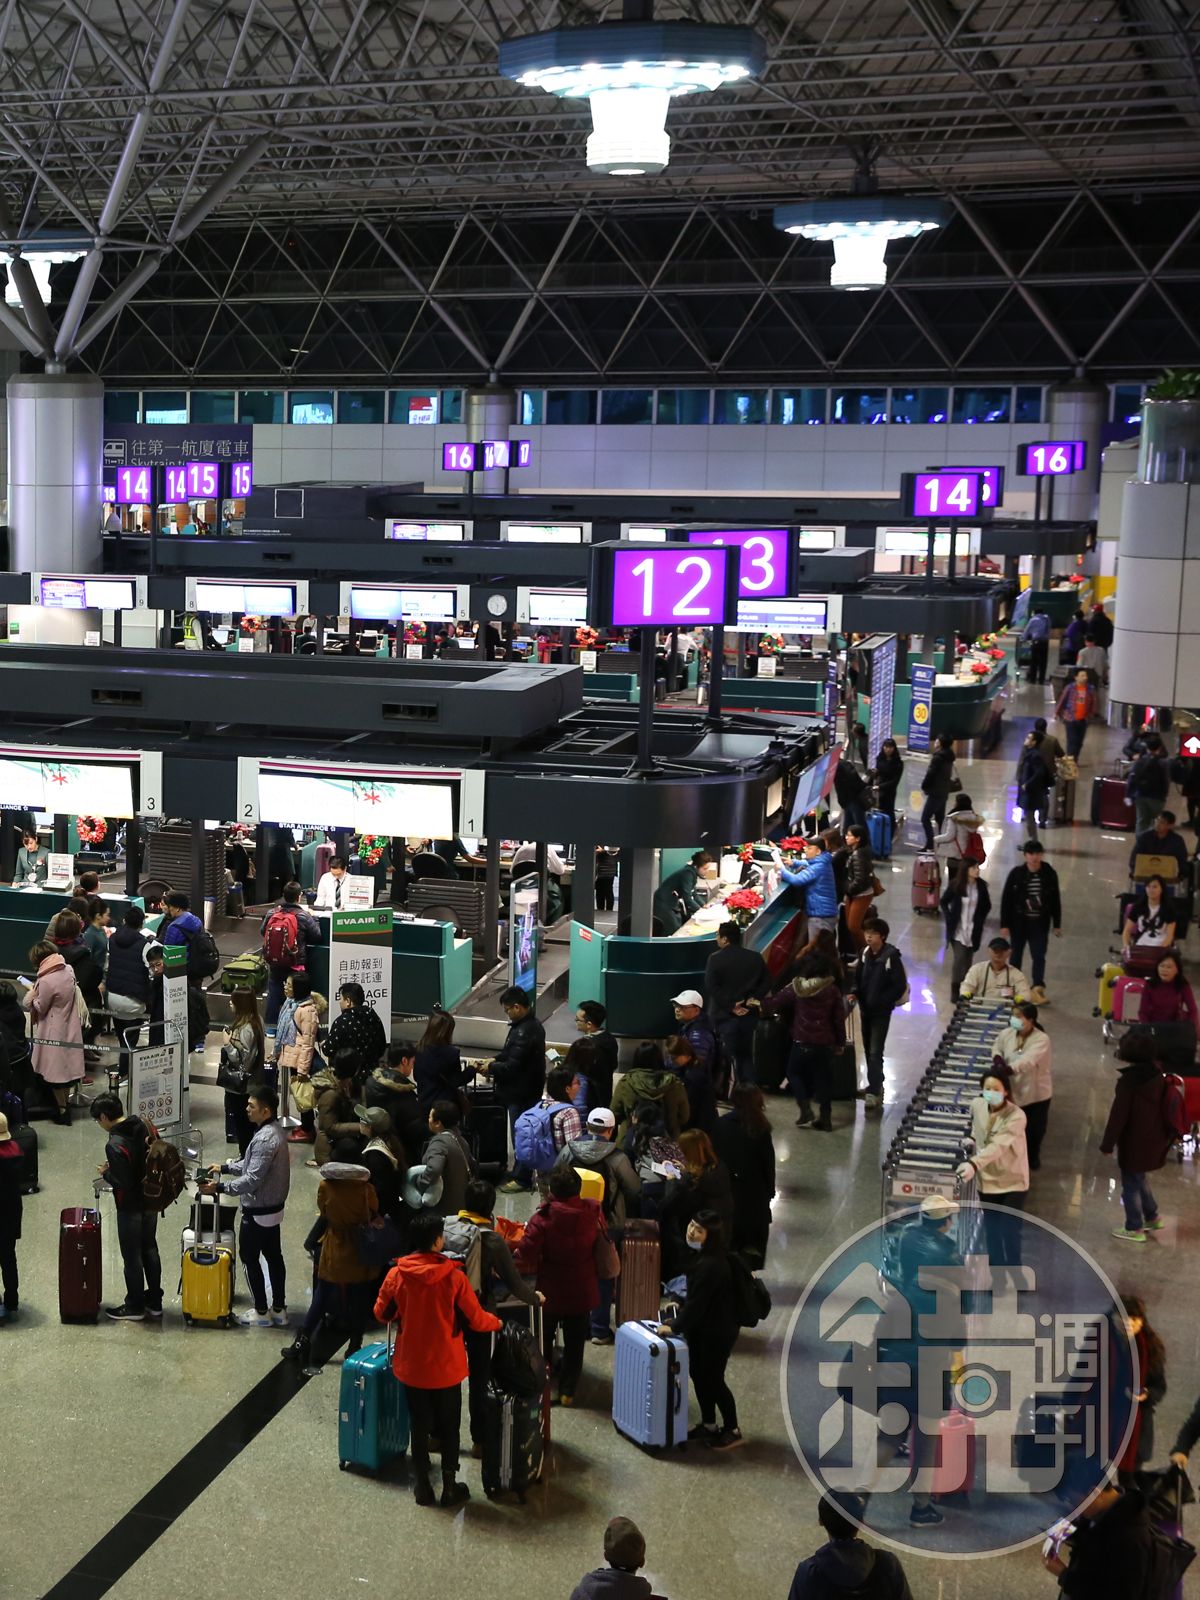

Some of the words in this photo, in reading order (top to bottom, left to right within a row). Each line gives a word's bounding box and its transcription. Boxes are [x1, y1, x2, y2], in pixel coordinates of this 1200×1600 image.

[132, 439, 249, 456] 往第一航廈電車
[448, 446, 472, 468] 16
[485, 446, 494, 468] 16
[495, 443, 506, 464] 7
[520, 444, 529, 464] 17
[1033, 448, 1067, 472] 16
[122, 470, 148, 500] 14
[168, 470, 186, 499] 14
[190, 466, 215, 494] 15
[235, 466, 250, 494] 15
[104, 487, 116, 501] 18
[924, 478, 971, 512] 14
[631, 556, 712, 617] 12
[916, 706, 927, 719] 30
[147, 798, 155, 810] 3
[245, 804, 253, 817] 2
[468, 820, 474, 832] 1
[340, 958, 382, 971] 自助報到
[339, 971, 382, 985] 行李託運
[335, 989, 388, 1001] BAGE
